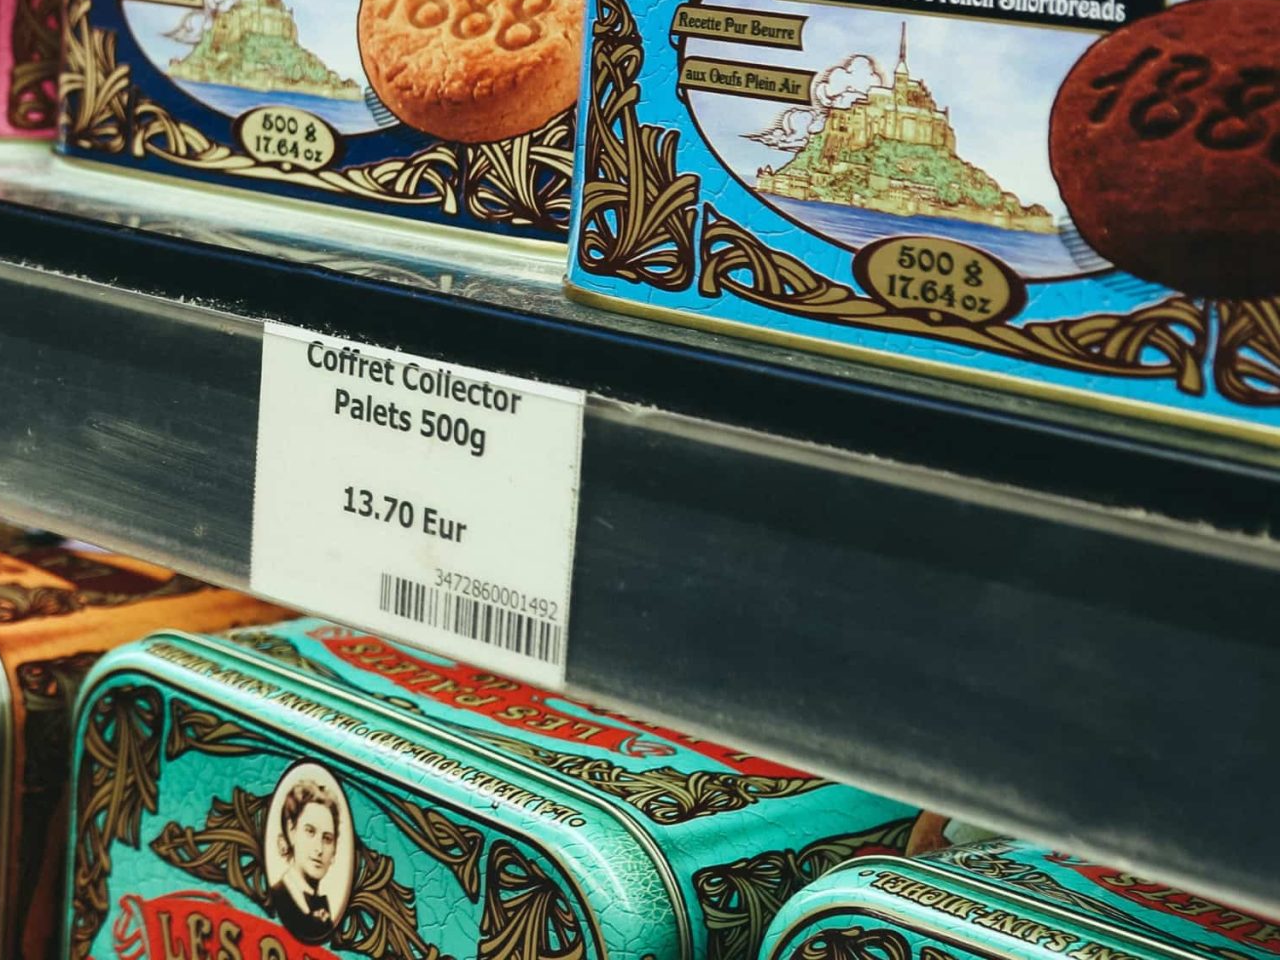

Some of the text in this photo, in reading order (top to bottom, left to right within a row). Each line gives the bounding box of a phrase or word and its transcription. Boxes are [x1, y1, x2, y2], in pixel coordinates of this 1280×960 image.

[678, 11, 795, 40] Recette Pur Beurre
[685, 67, 802, 95] aux Oeufs Plein Air
[1086, 45, 1280, 164] 188
[255, 135, 323, 163] 17.64 oz
[262, 112, 299, 135] 500
[897, 245, 984, 288] 500 g
[887, 274, 992, 315] 17.64 oz
[307, 340, 523, 415] Coffret Collector
[334, 388, 487, 457] Palets 500g
[343, 486, 468, 543] 13.70 Eur
[433, 568, 559, 622] 3472860001492
[157, 909, 244, 960] LES
[872, 870, 1074, 958] SAINT-MICHEL
